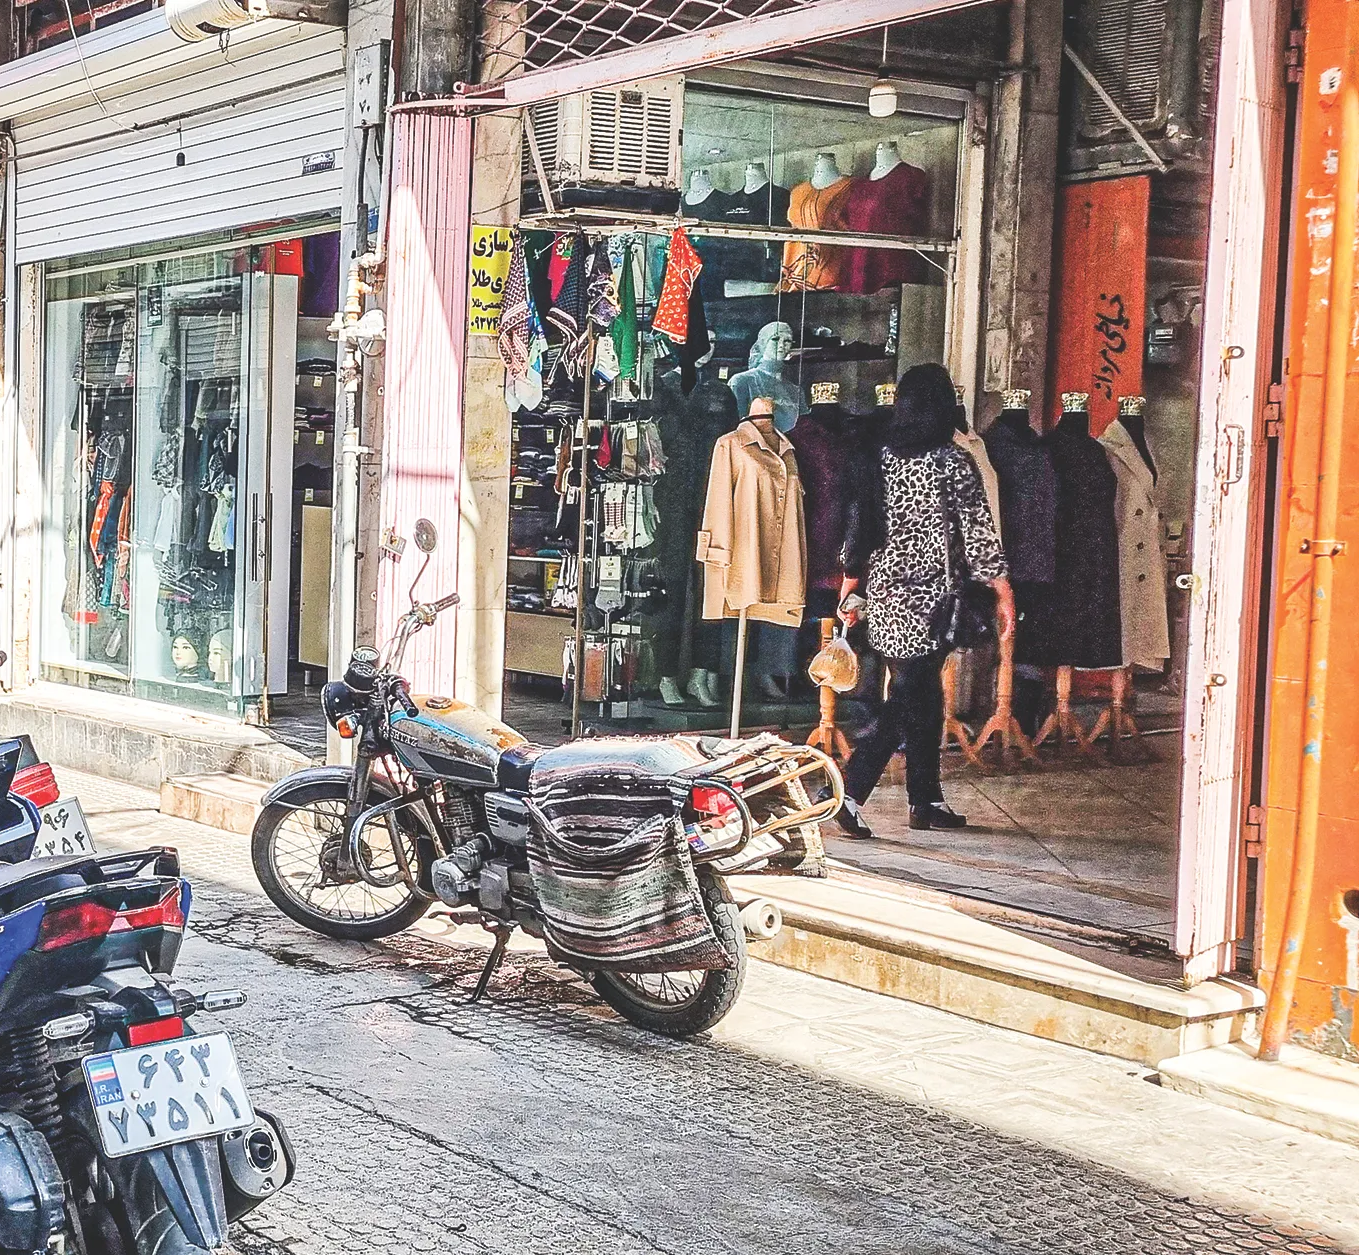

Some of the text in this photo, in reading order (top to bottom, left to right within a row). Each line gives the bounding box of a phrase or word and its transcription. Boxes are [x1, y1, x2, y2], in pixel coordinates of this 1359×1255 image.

[471, 269, 491, 287] طلا
[137, 1042, 211, 1089] ۶۴۳
[96, 1091, 123, 1105] IRAN
[108, 1086, 241, 1144] ۷۳۵۱۱
